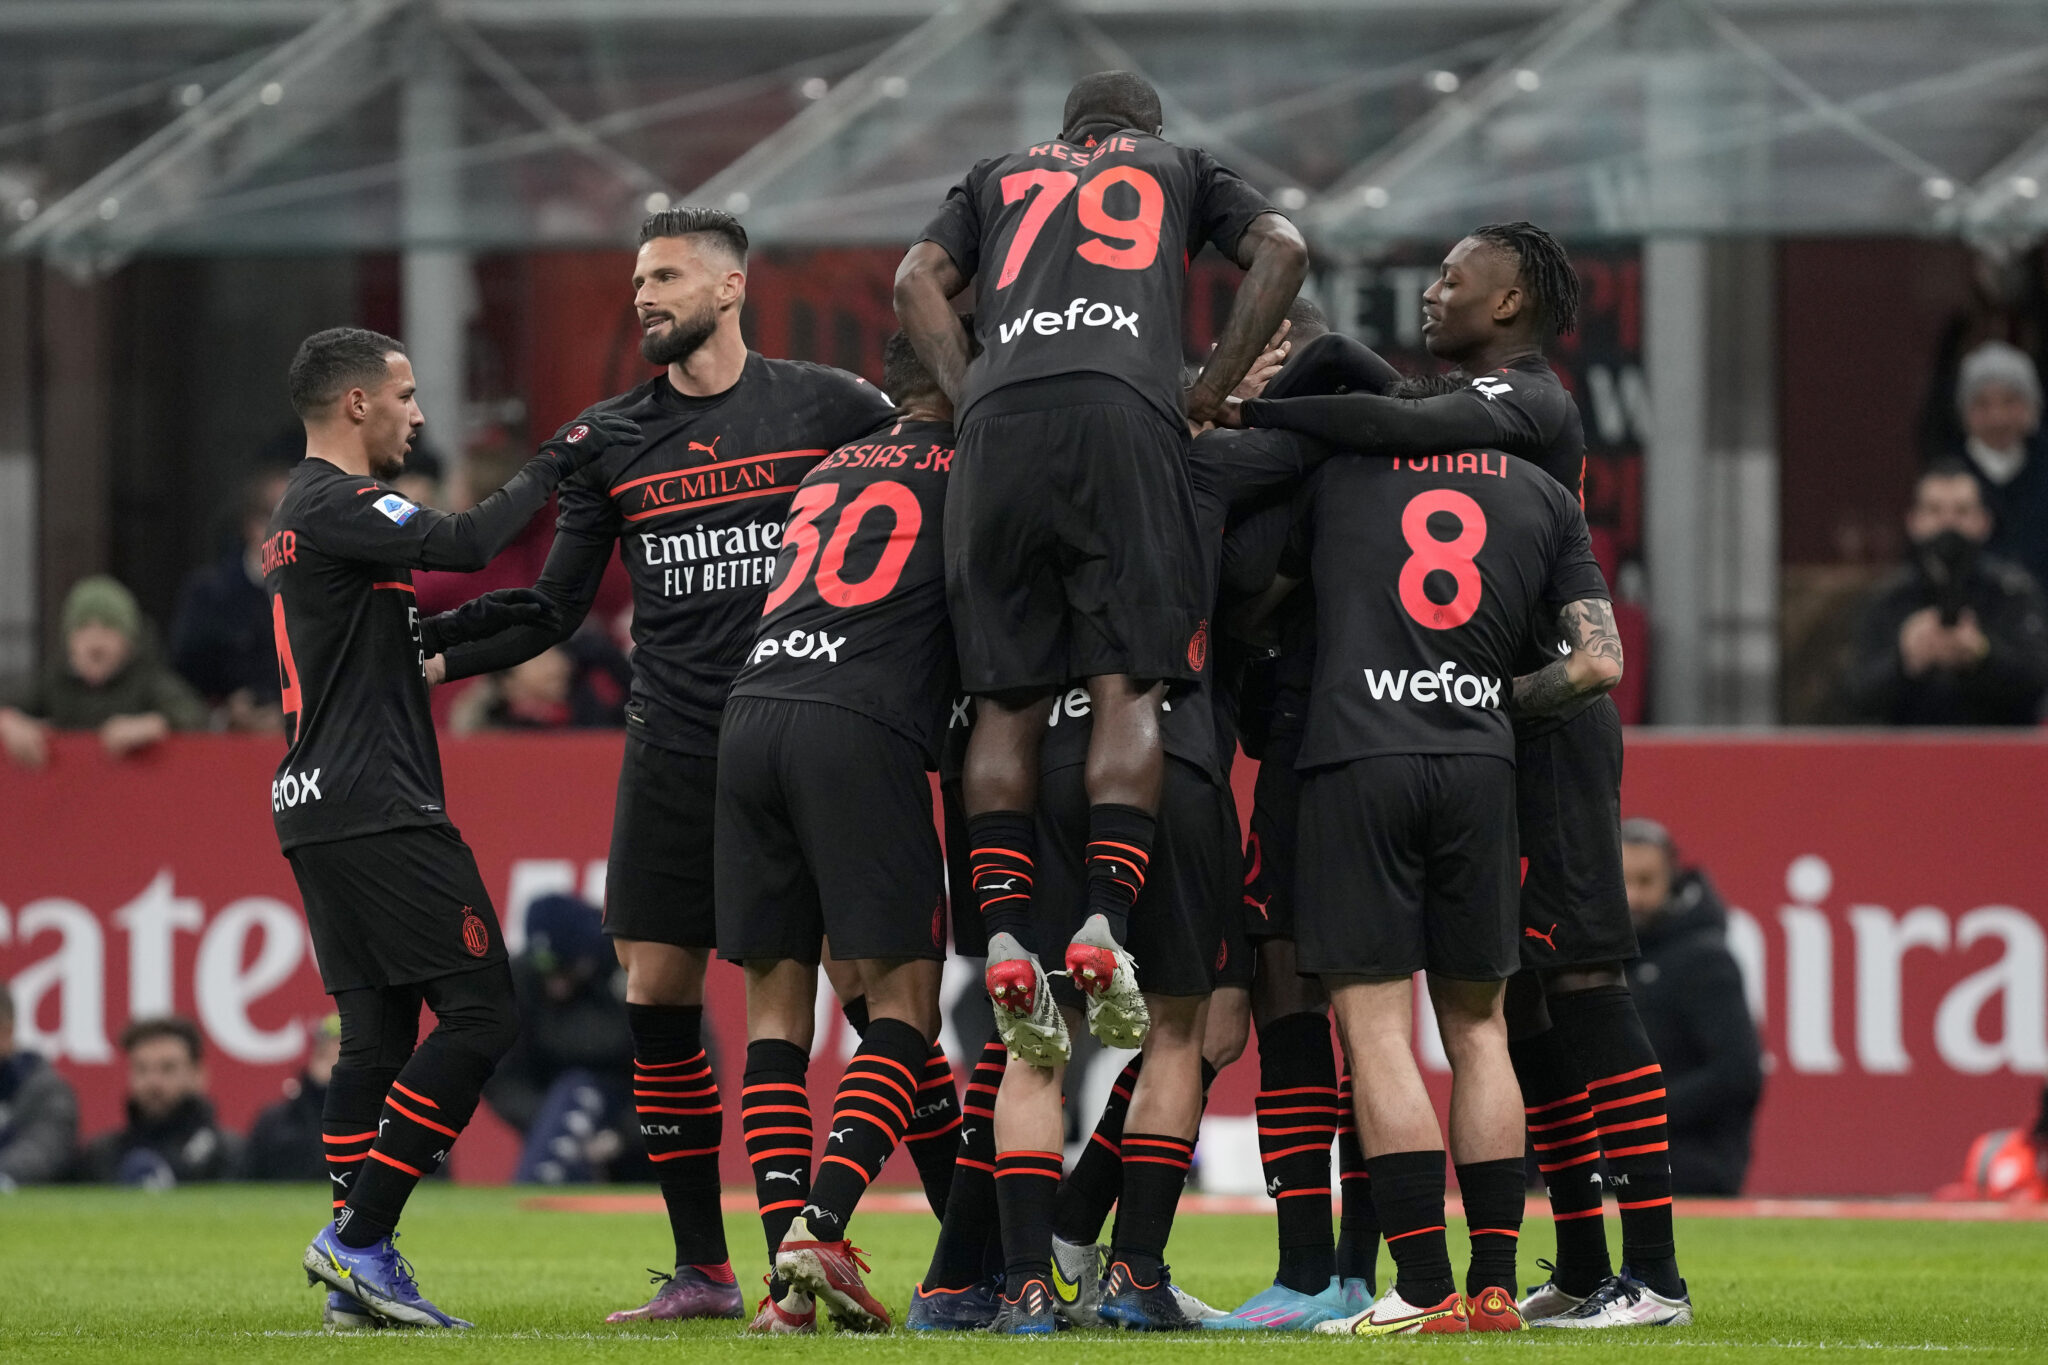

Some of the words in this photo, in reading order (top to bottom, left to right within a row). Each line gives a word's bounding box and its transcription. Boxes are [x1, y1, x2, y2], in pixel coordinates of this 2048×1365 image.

[1028, 137, 1137, 167] KESSIE
[996, 165, 1165, 291] 79
[998, 297, 1140, 344] wefox
[680, 462, 775, 500] MILAN
[639, 519, 787, 566] Emirate
[762, 480, 923, 616] 30
[1398, 488, 1488, 631] 8
[664, 566, 695, 597] FLY
[703, 555, 777, 592] BETTER
[1363, 660, 1502, 709] wefox
[271, 766, 322, 813] efox
[0, 867, 320, 1065] ate
